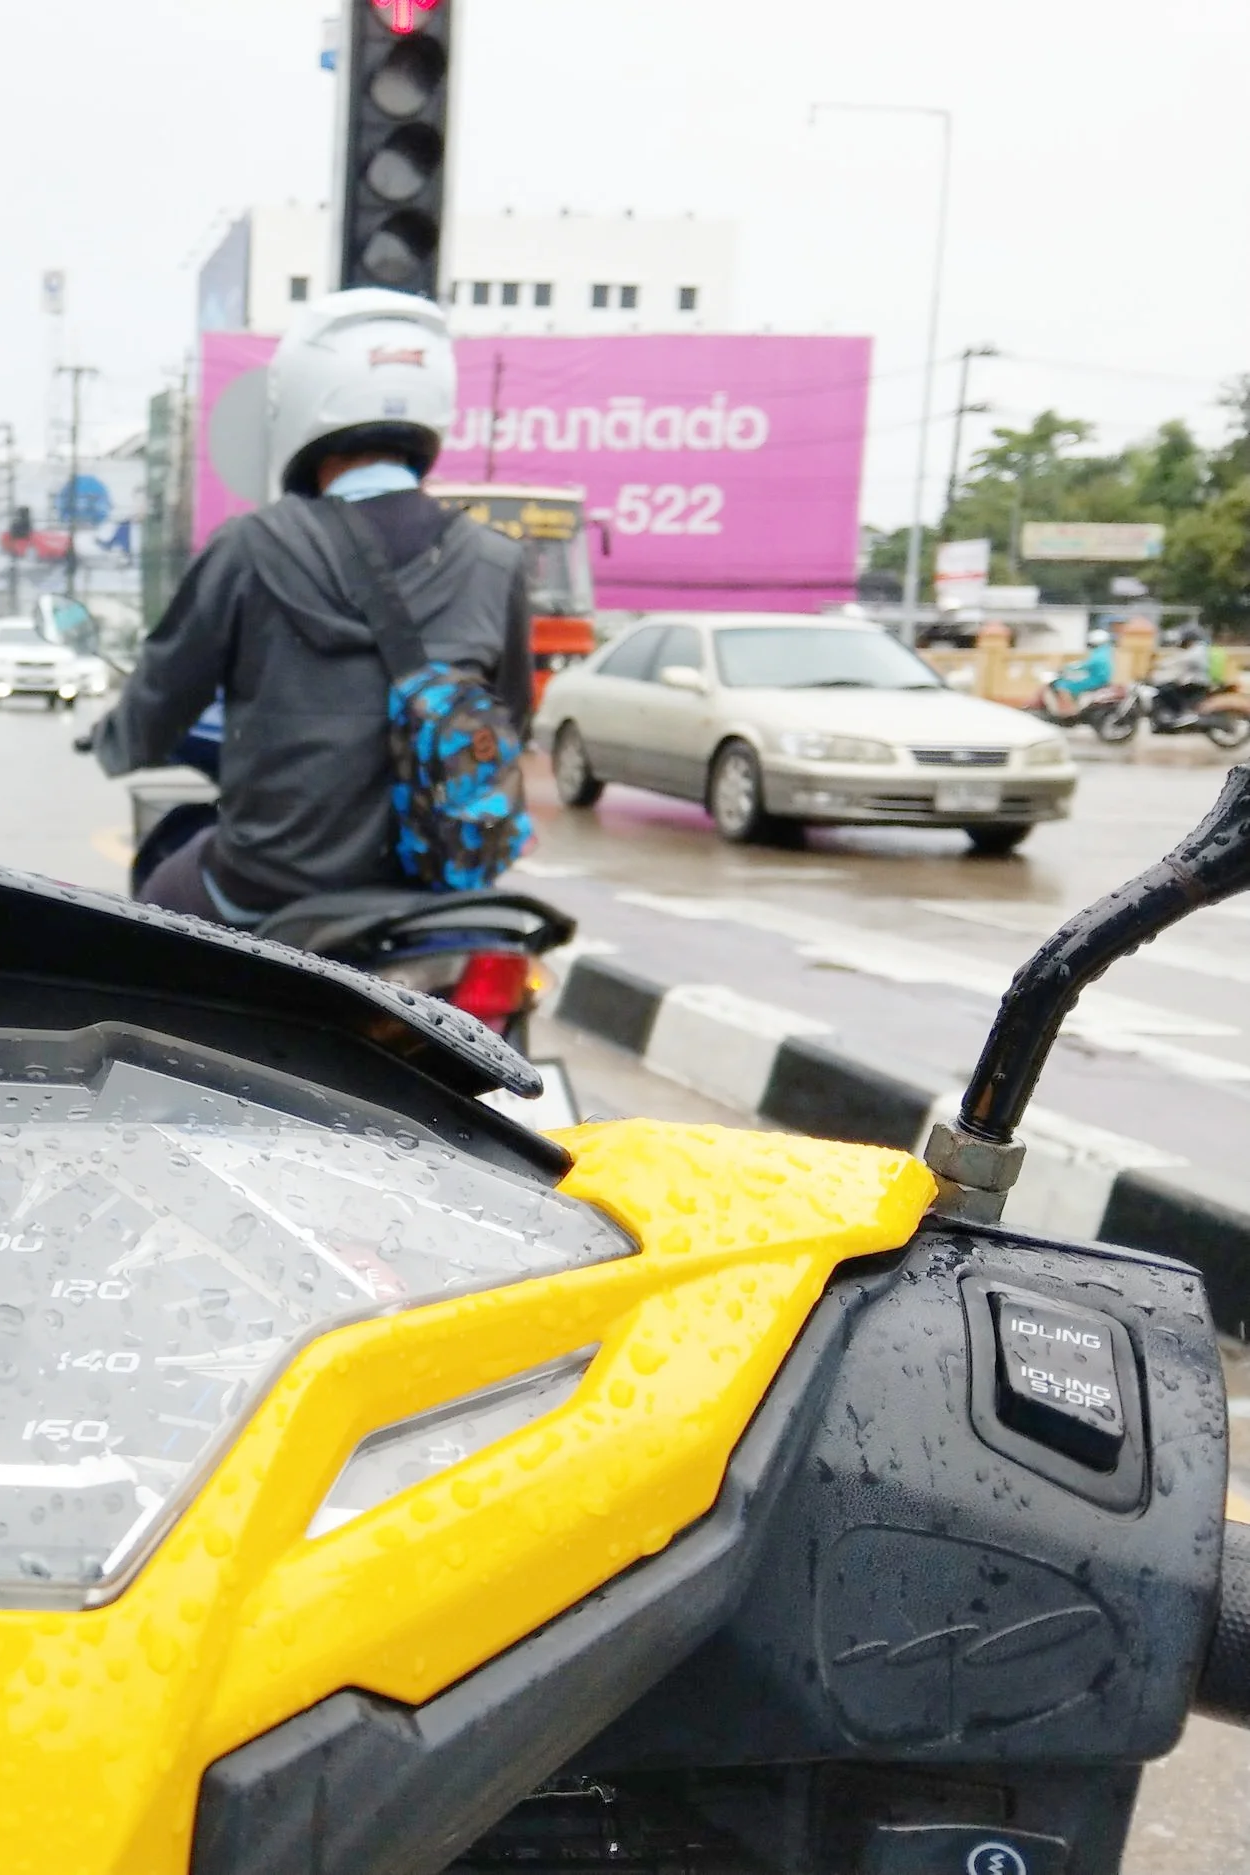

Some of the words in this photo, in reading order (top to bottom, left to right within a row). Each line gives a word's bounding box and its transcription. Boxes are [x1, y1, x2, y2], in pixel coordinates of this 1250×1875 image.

[50, 1279, 130, 1300] 120
[1011, 1318, 1102, 1350] IDLING
[56, 1350, 141, 1373] 140
[1021, 1365, 1112, 1400] IDLING
[1030, 1380, 1105, 1408] STOP
